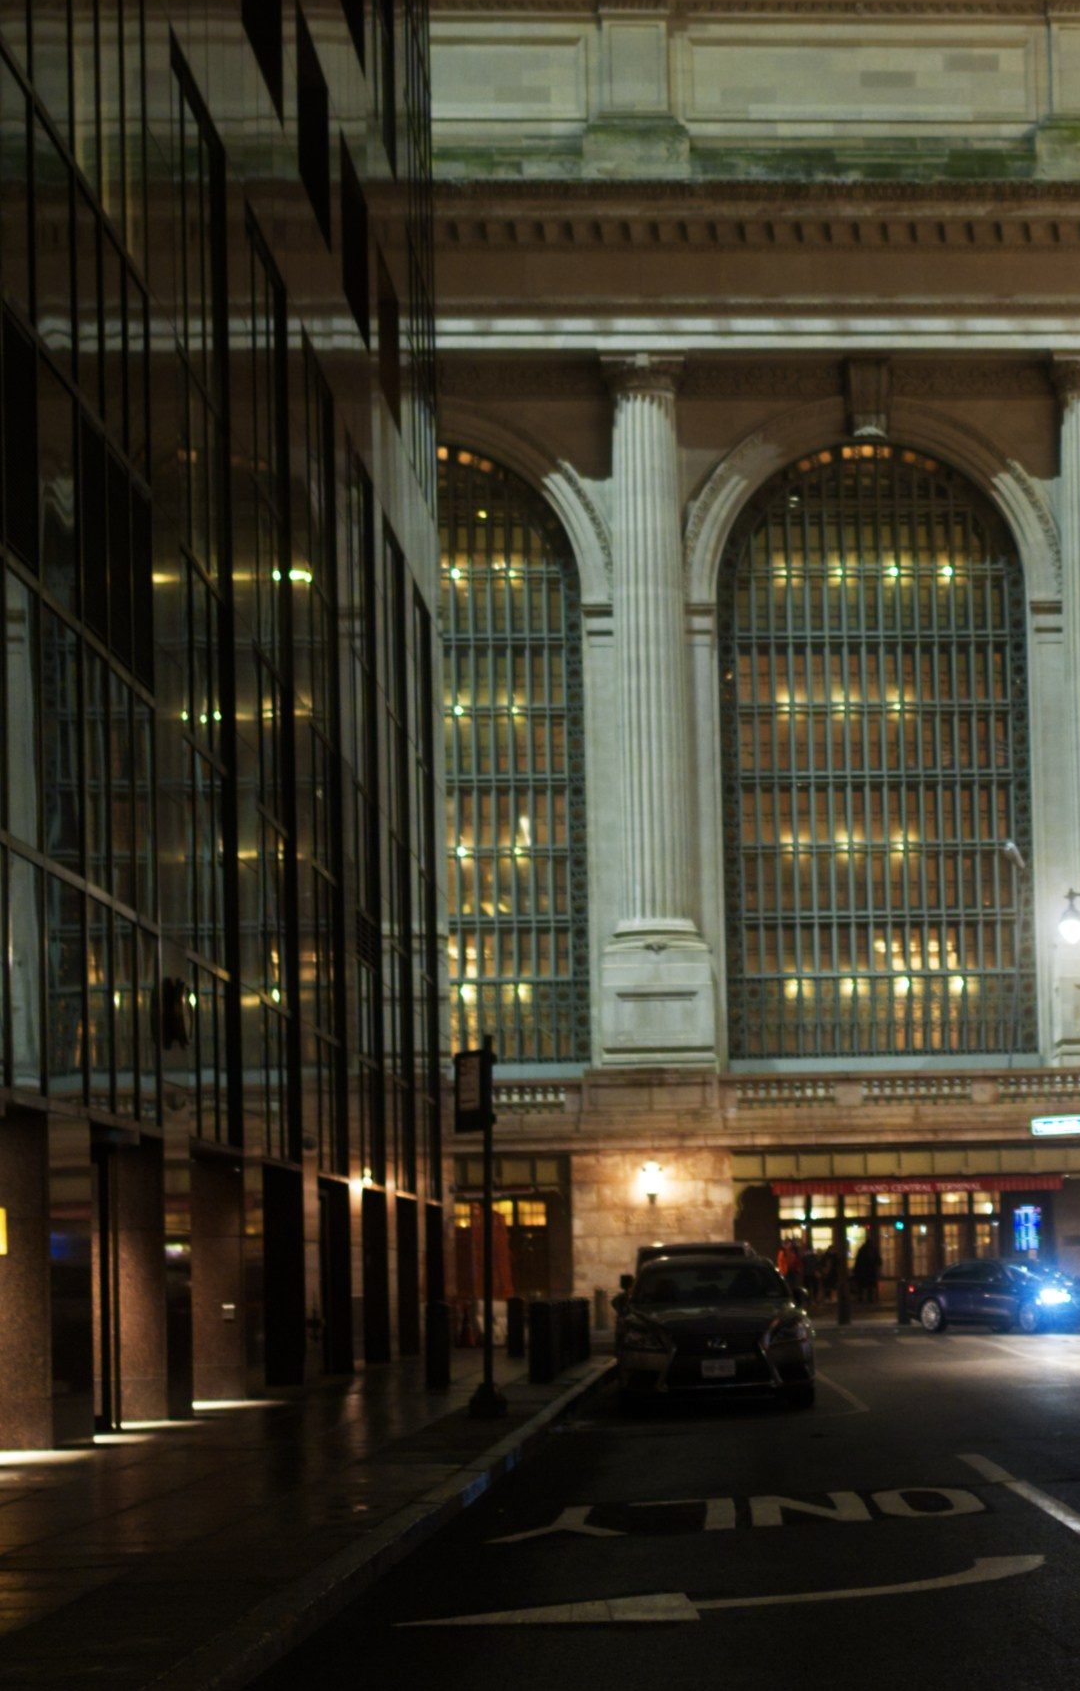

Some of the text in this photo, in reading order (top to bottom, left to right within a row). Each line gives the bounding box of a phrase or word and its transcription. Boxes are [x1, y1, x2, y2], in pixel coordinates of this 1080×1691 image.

[854, 1182, 981, 1193] GRAND CENTRAL TERMINAL
[485, 1487, 986, 1544] ONLY
